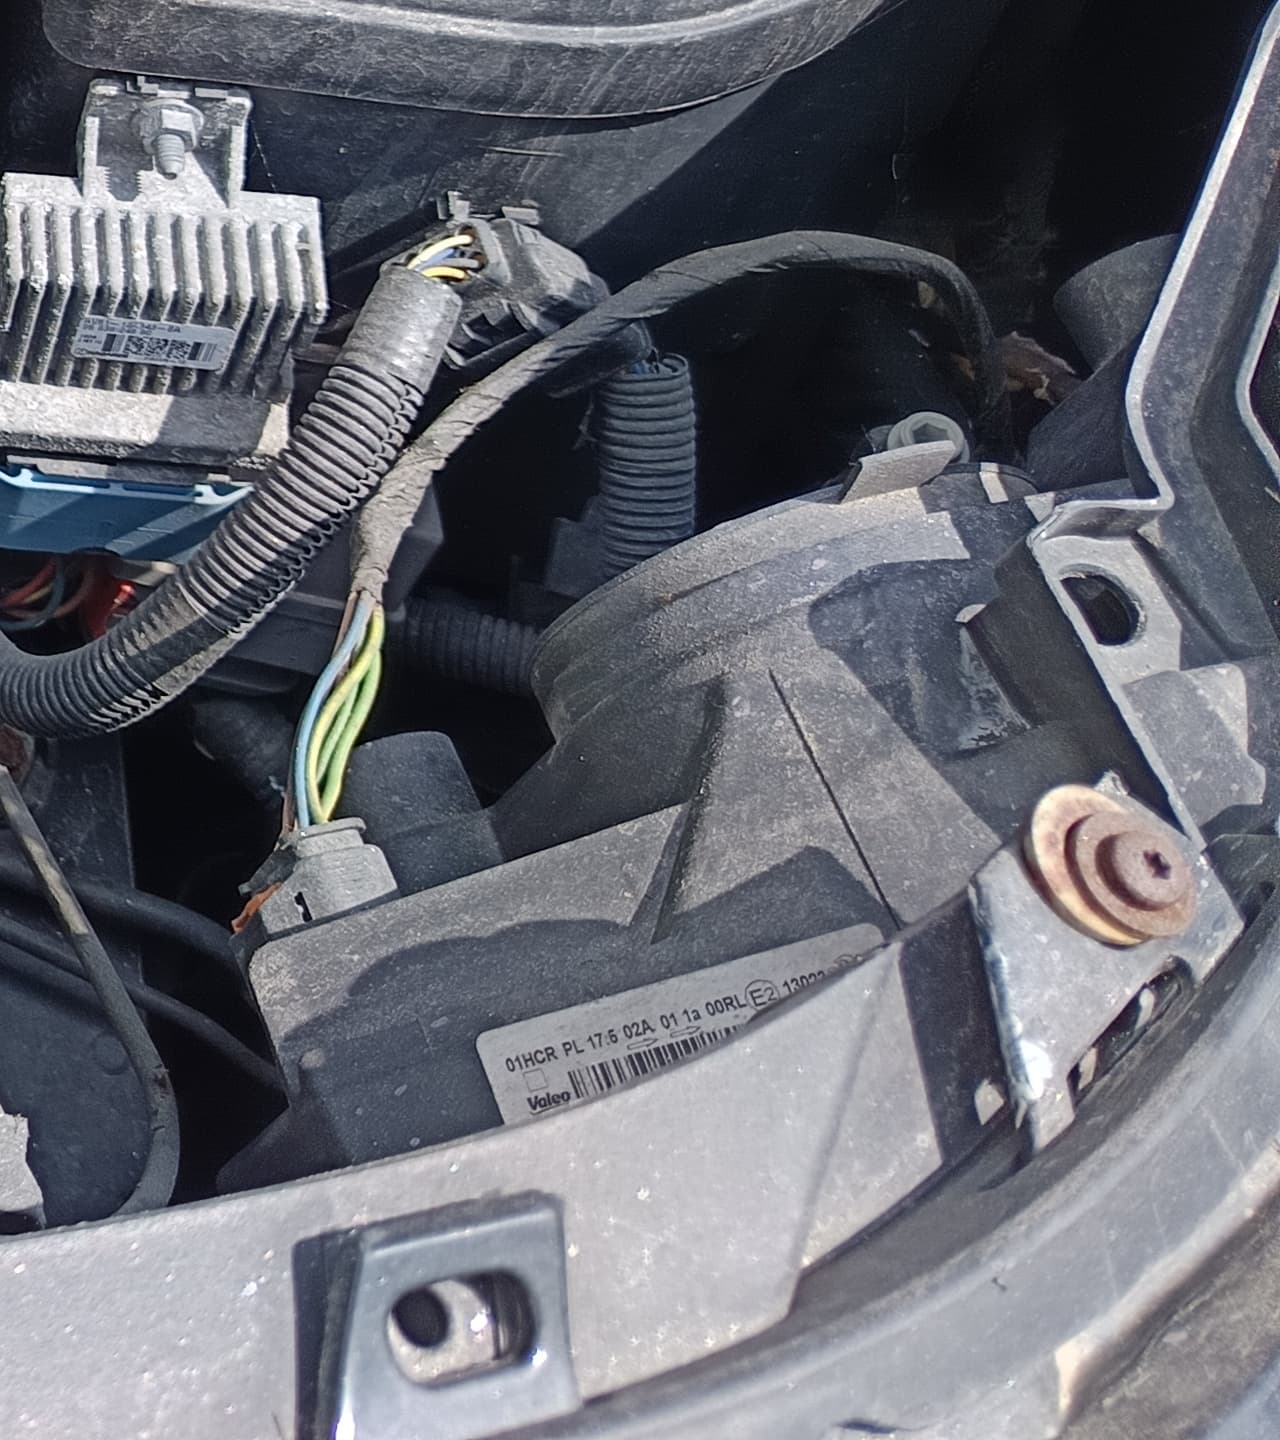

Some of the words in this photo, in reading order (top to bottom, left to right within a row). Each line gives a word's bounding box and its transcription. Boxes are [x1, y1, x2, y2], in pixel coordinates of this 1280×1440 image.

[505, 1045, 559, 1074] 01HCR
[562, 1039, 585, 1057] PL
[659, 1011, 678, 1030] 01
[682, 1006, 702, 1024] 1a
[705, 994, 747, 1017] 00RL
[748, 986, 778, 1007] E2
[527, 1089, 572, 1113] Valeo
